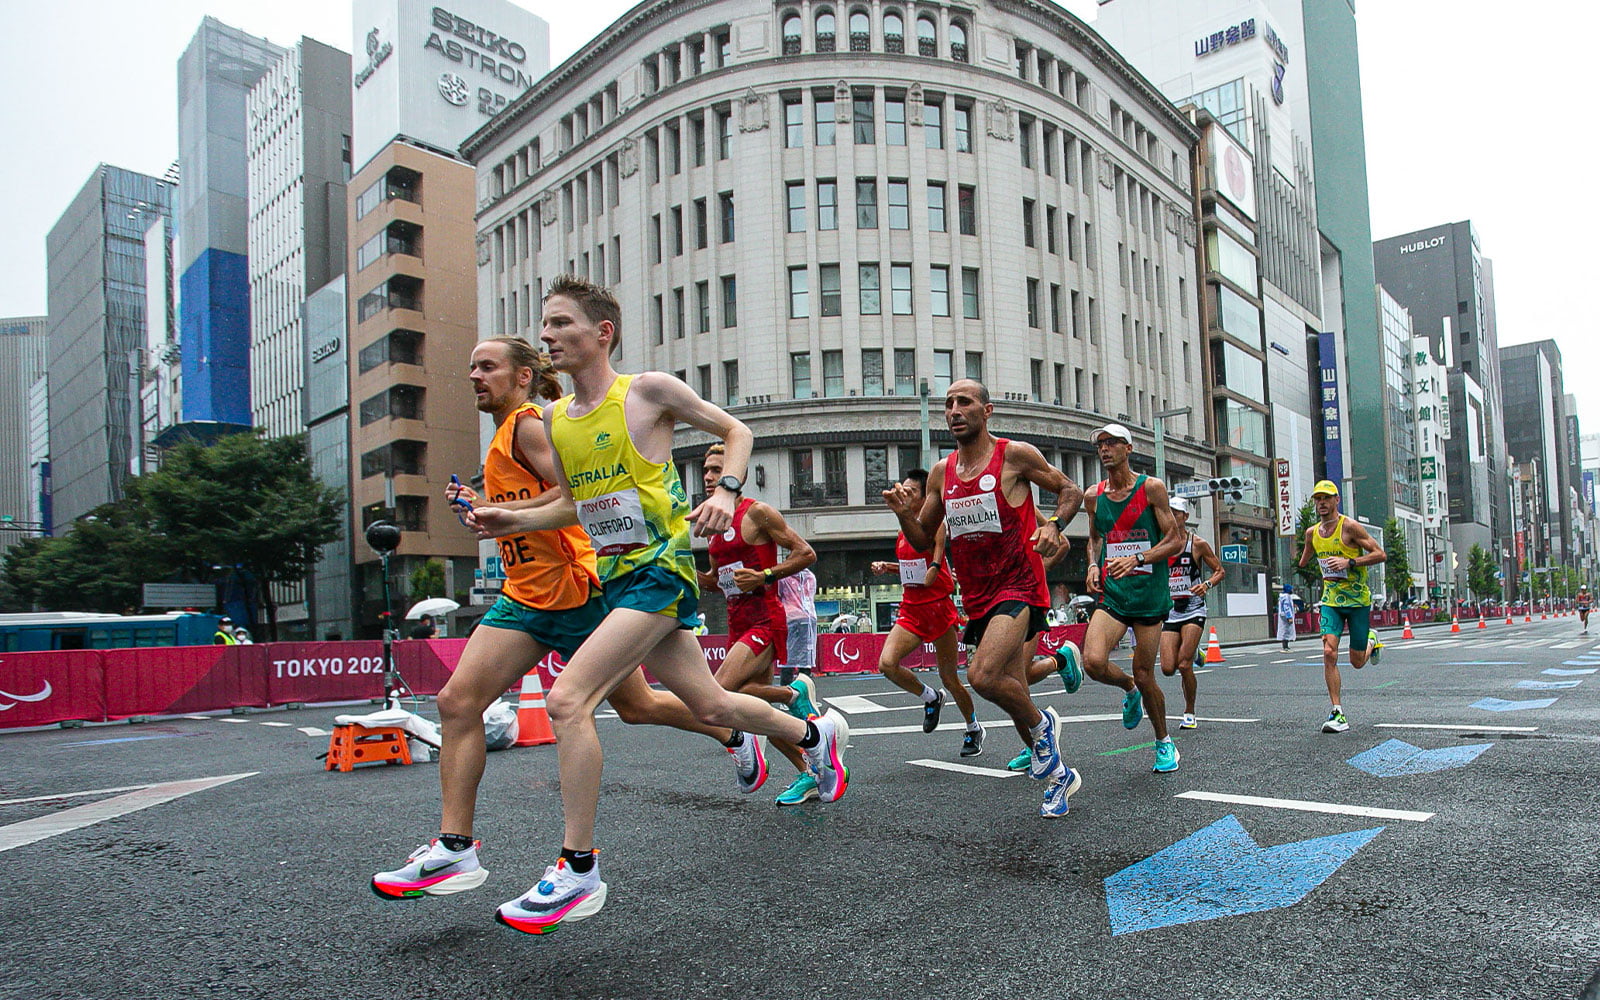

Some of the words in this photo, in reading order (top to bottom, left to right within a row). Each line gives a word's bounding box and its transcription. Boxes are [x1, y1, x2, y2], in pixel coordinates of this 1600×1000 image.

[432, 7, 527, 64] SEIKO
[424, 32, 533, 89] ASTRON
[478, 87, 514, 107] GP
[1400, 235, 1446, 255] HUBLOT
[569, 463, 628, 488] USTRALIA
[1422, 460, 1435, 476] 本
[582, 497, 620, 513] TOYOTA
[951, 497, 983, 510] TOYOTA
[1279, 480, 1292, 532] キムラヤのパン
[588, 516, 634, 537] CLIFFORD
[704, 647, 726, 661] KYO
[273, 657, 343, 679] TOKYO
[347, 656, 384, 675] 202
